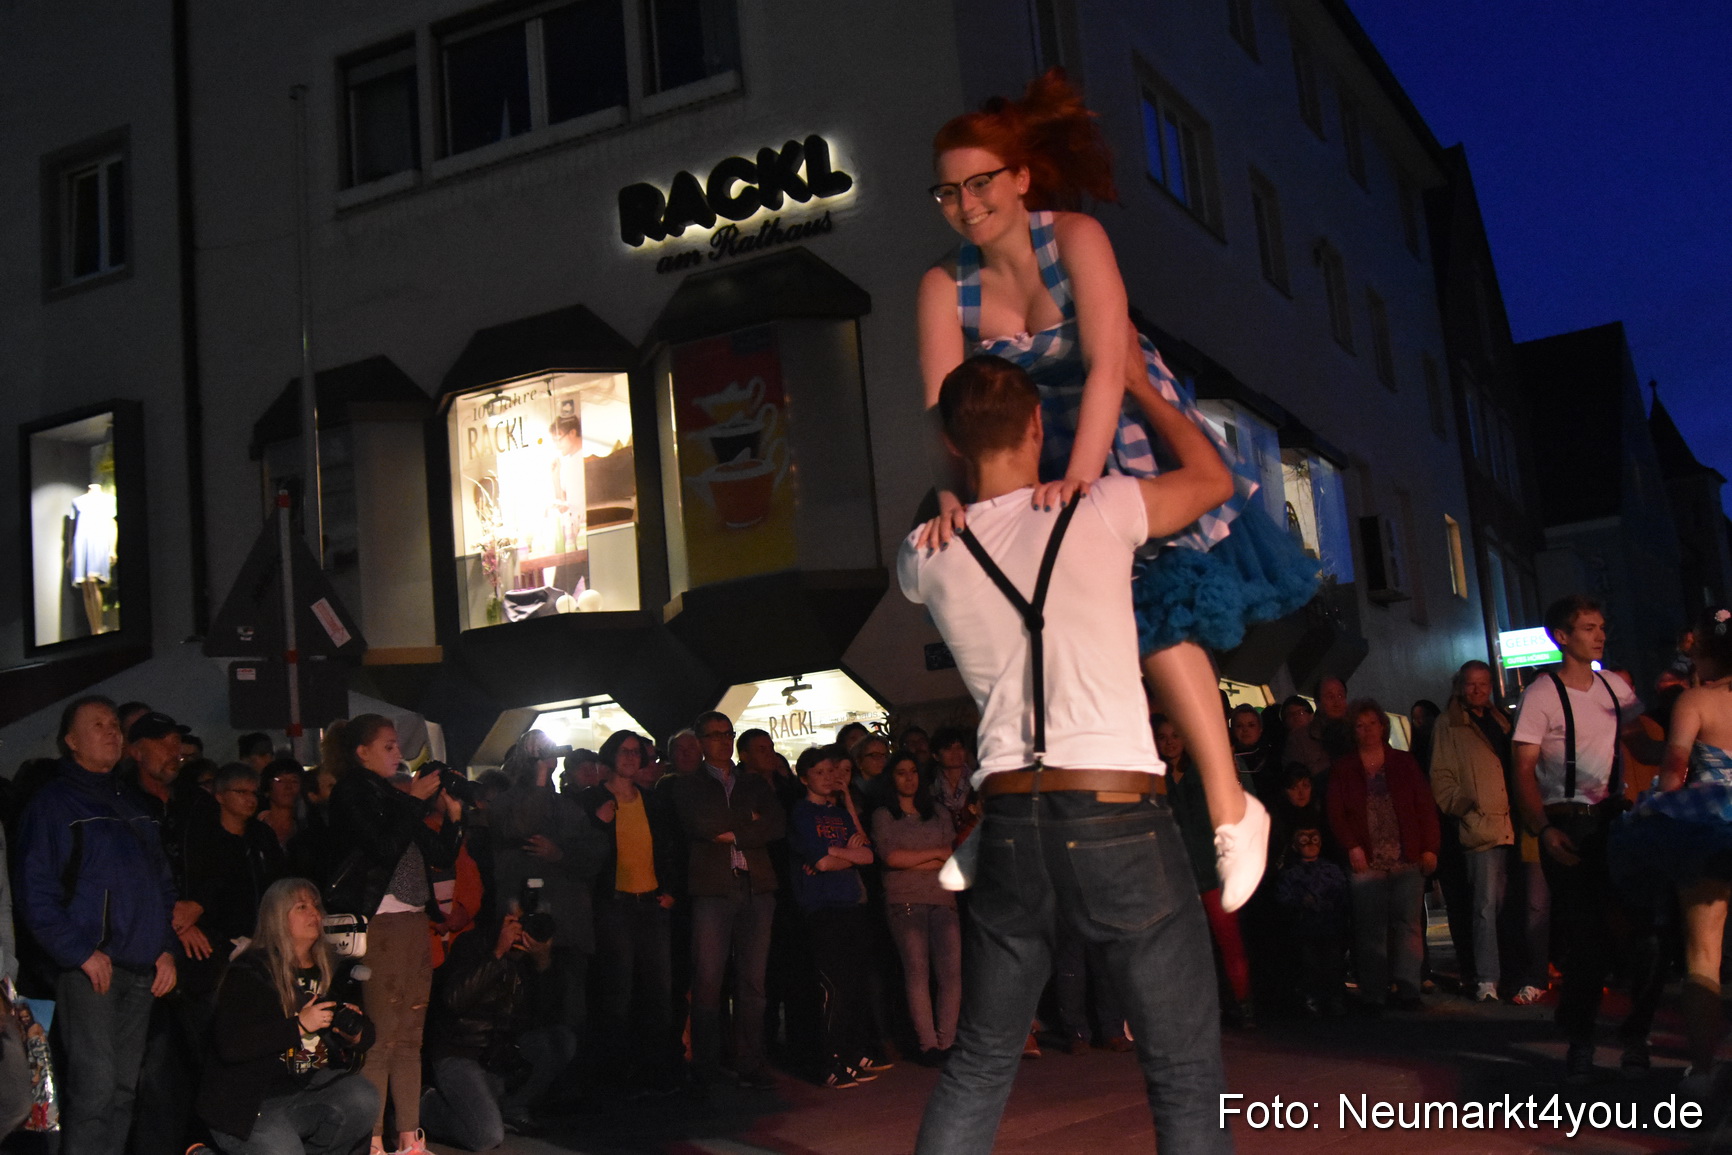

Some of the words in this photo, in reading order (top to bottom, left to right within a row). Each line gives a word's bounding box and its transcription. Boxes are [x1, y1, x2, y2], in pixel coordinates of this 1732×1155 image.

[618, 134, 853, 247] RACKL
[656, 250, 703, 274] am
[708, 210, 833, 261] Rathaus
[1505, 633, 1547, 649] GEERS
[769, 711, 817, 739] RACKL
